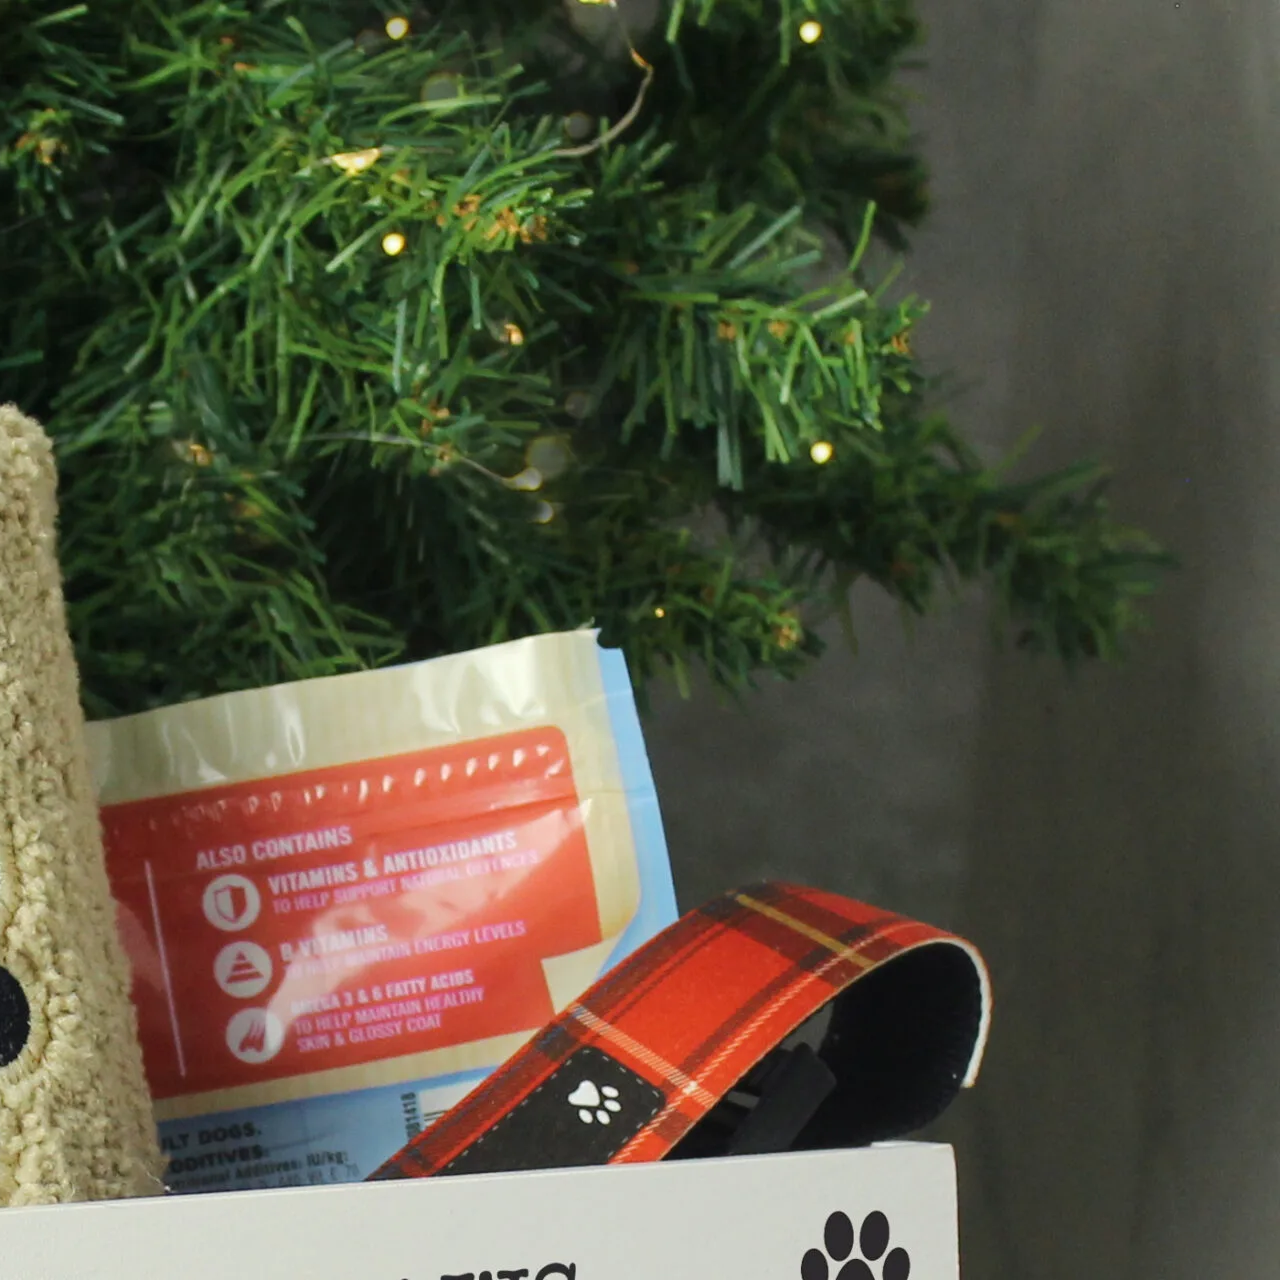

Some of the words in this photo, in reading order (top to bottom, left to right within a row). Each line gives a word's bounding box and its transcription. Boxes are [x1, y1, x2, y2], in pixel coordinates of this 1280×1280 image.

[196, 844, 246, 870] ALSO
[252, 825, 353, 861] CONTAINS
[268, 862, 358, 895] VITAMINS
[363, 858, 379, 878] &
[383, 830, 517, 875] ANTIOXIDANTS
[273, 898, 291, 914] TO
[295, 892, 330, 911] HELP
[334, 878, 397, 905] SUPPORT
[414, 930, 471, 955] ENERGY
[474, 920, 526, 944] LEVELS
[357, 988, 368, 1003] &
[385, 977, 426, 998] FATTY
[430, 968, 474, 991] ACIDS
[295, 1017, 312, 1035] TO
[315, 1012, 352, 1031] HELP
[354, 999, 421, 1024] MAINTAIN
[424, 986, 484, 1011] HEALTHY
[297, 1033, 330, 1053] SKIN
[334, 1031, 346, 1047] &
[349, 1021, 402, 1044] GLOSSY
[406, 1012, 442, 1032] COAT
[198, 1121, 262, 1145] DOGS.
